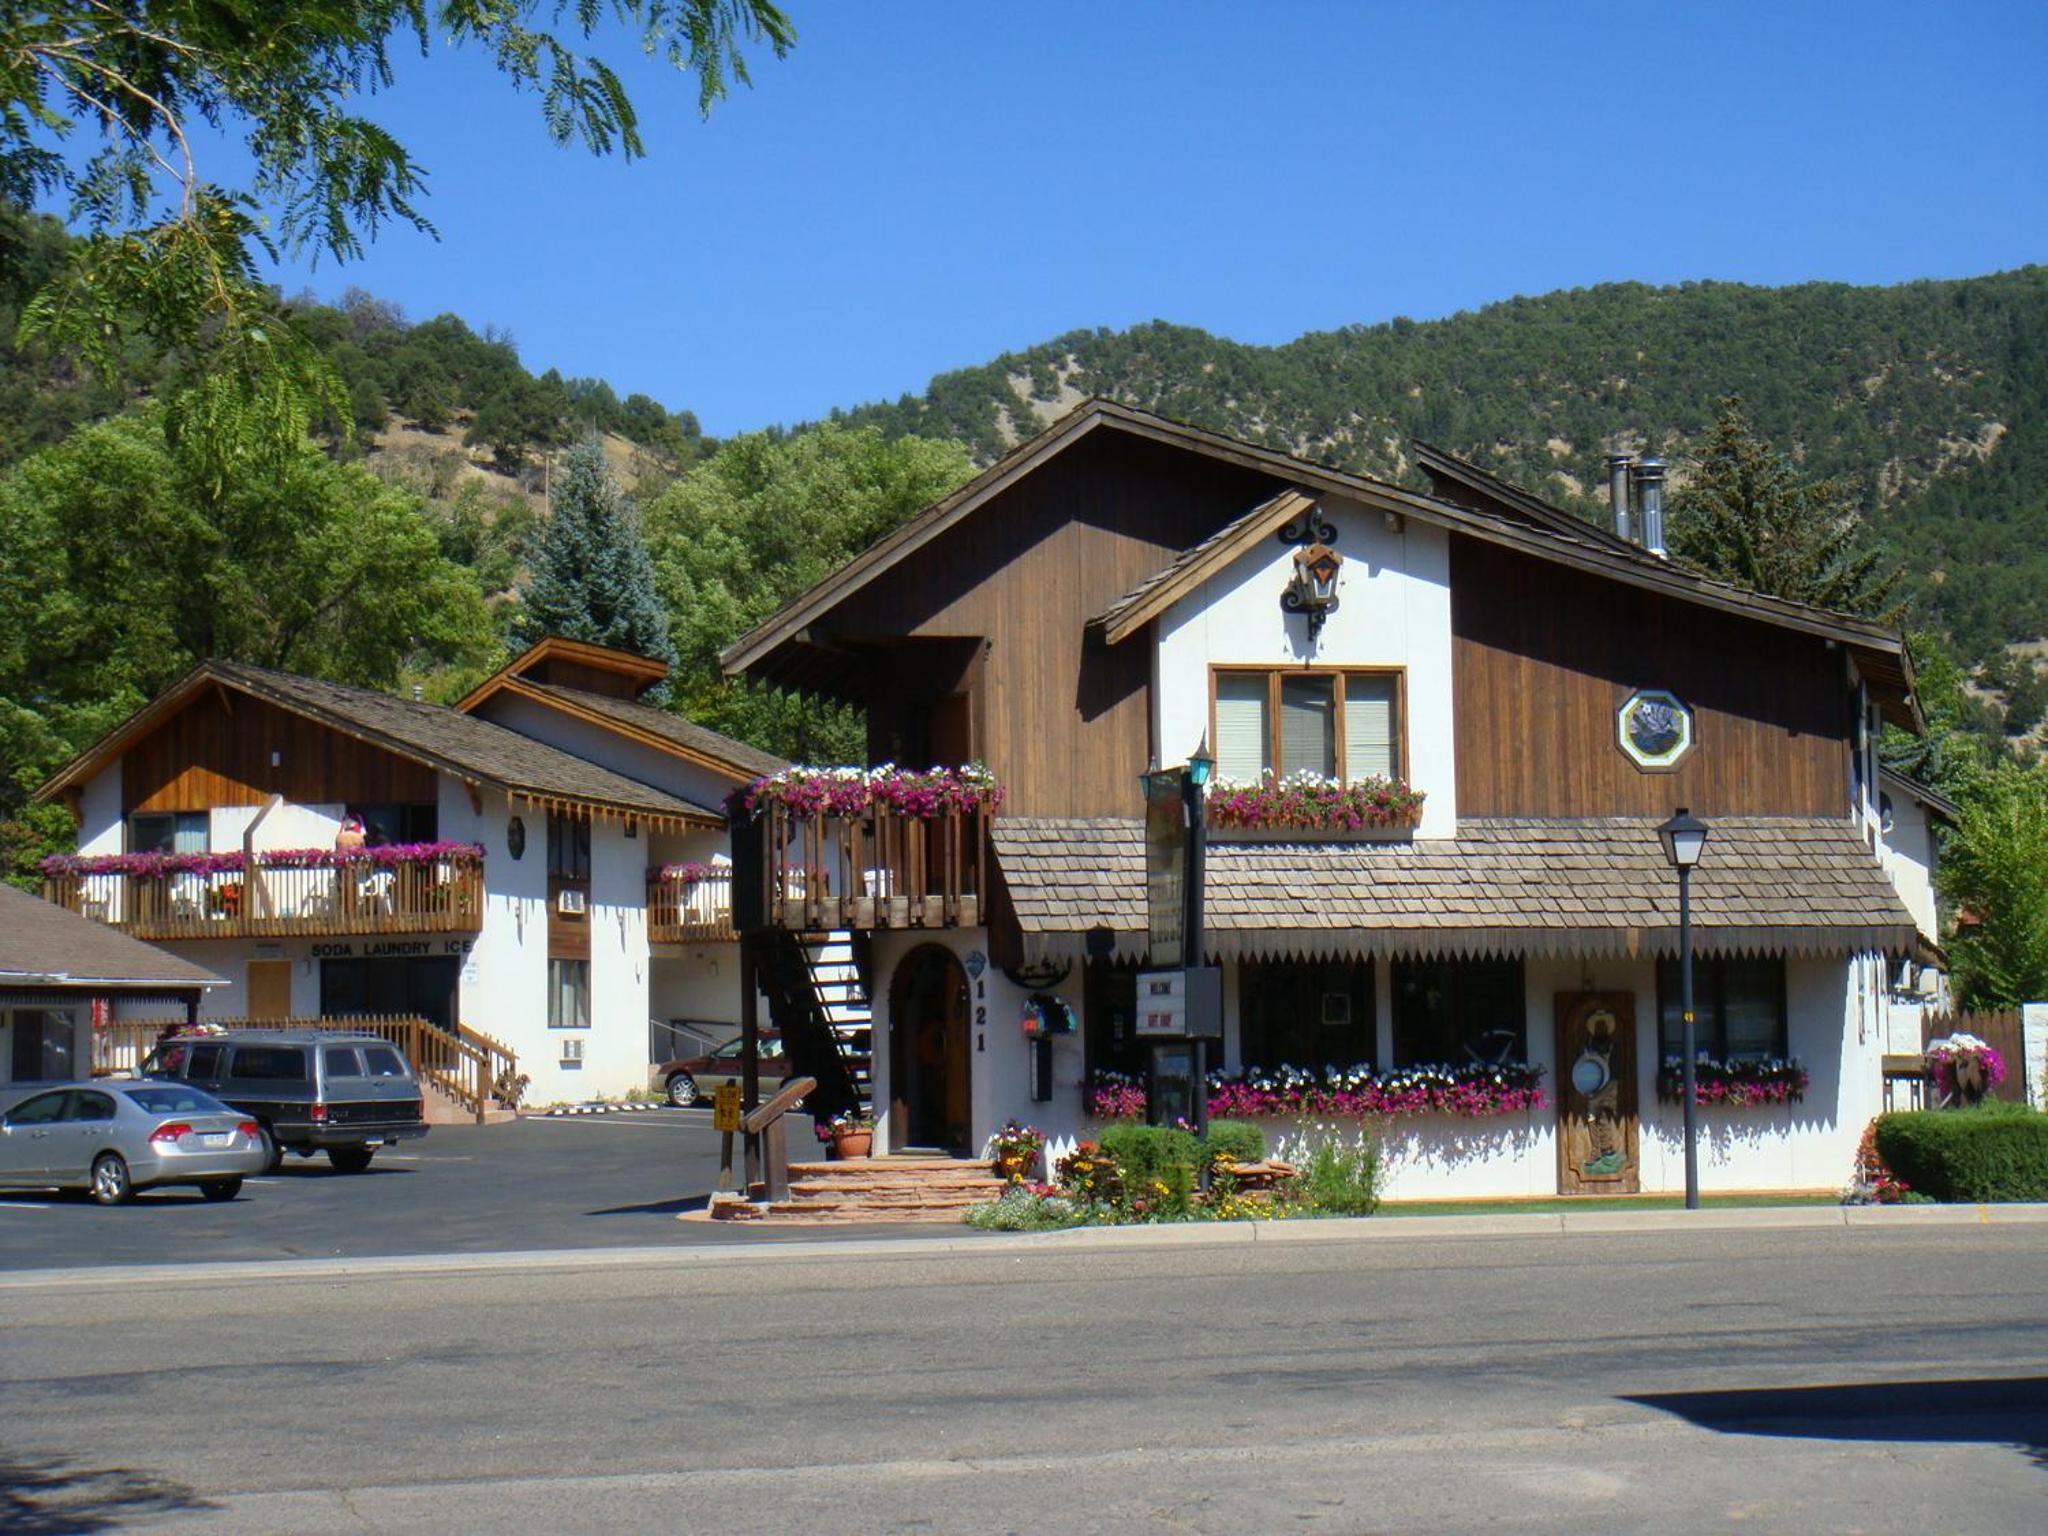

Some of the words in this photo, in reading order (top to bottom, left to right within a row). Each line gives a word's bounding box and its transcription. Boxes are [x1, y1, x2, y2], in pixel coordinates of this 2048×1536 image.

[312, 943, 352, 957] SODA
[364, 941, 432, 956] LAUNDRY
[444, 940, 473, 953] ICE
[976, 980, 986, 1052] 121
